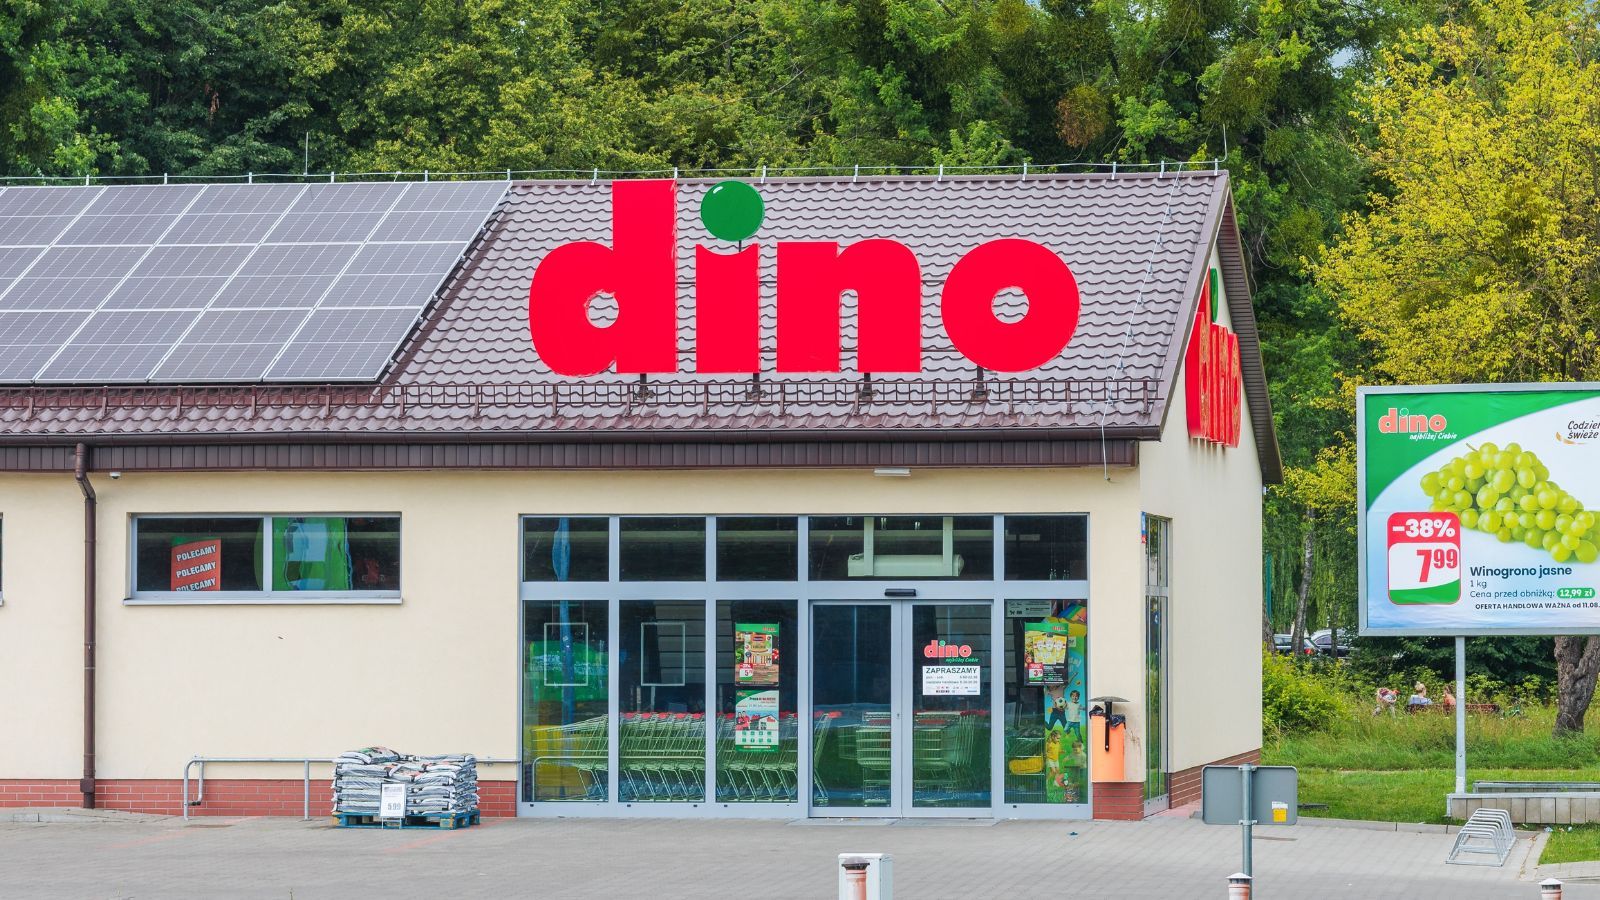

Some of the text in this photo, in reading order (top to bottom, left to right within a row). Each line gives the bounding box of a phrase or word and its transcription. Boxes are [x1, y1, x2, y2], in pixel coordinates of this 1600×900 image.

[528, 179, 1081, 377] dino
[1378, 408, 1447, 433] dino
[1568, 430, 1599, 439] świeże
[1392, 518, 1456, 538] -38%
[176, 545, 216, 562] POLECAMY
[176, 561, 216, 578] POLECAMY
[1470, 565, 1573, 579] Winogrono jasne
[1470, 580, 1487, 589] 1 kg
[1470, 589, 1593, 599] Cena przed obniżką: 12,99 zł
[924, 640, 972, 658] dino
